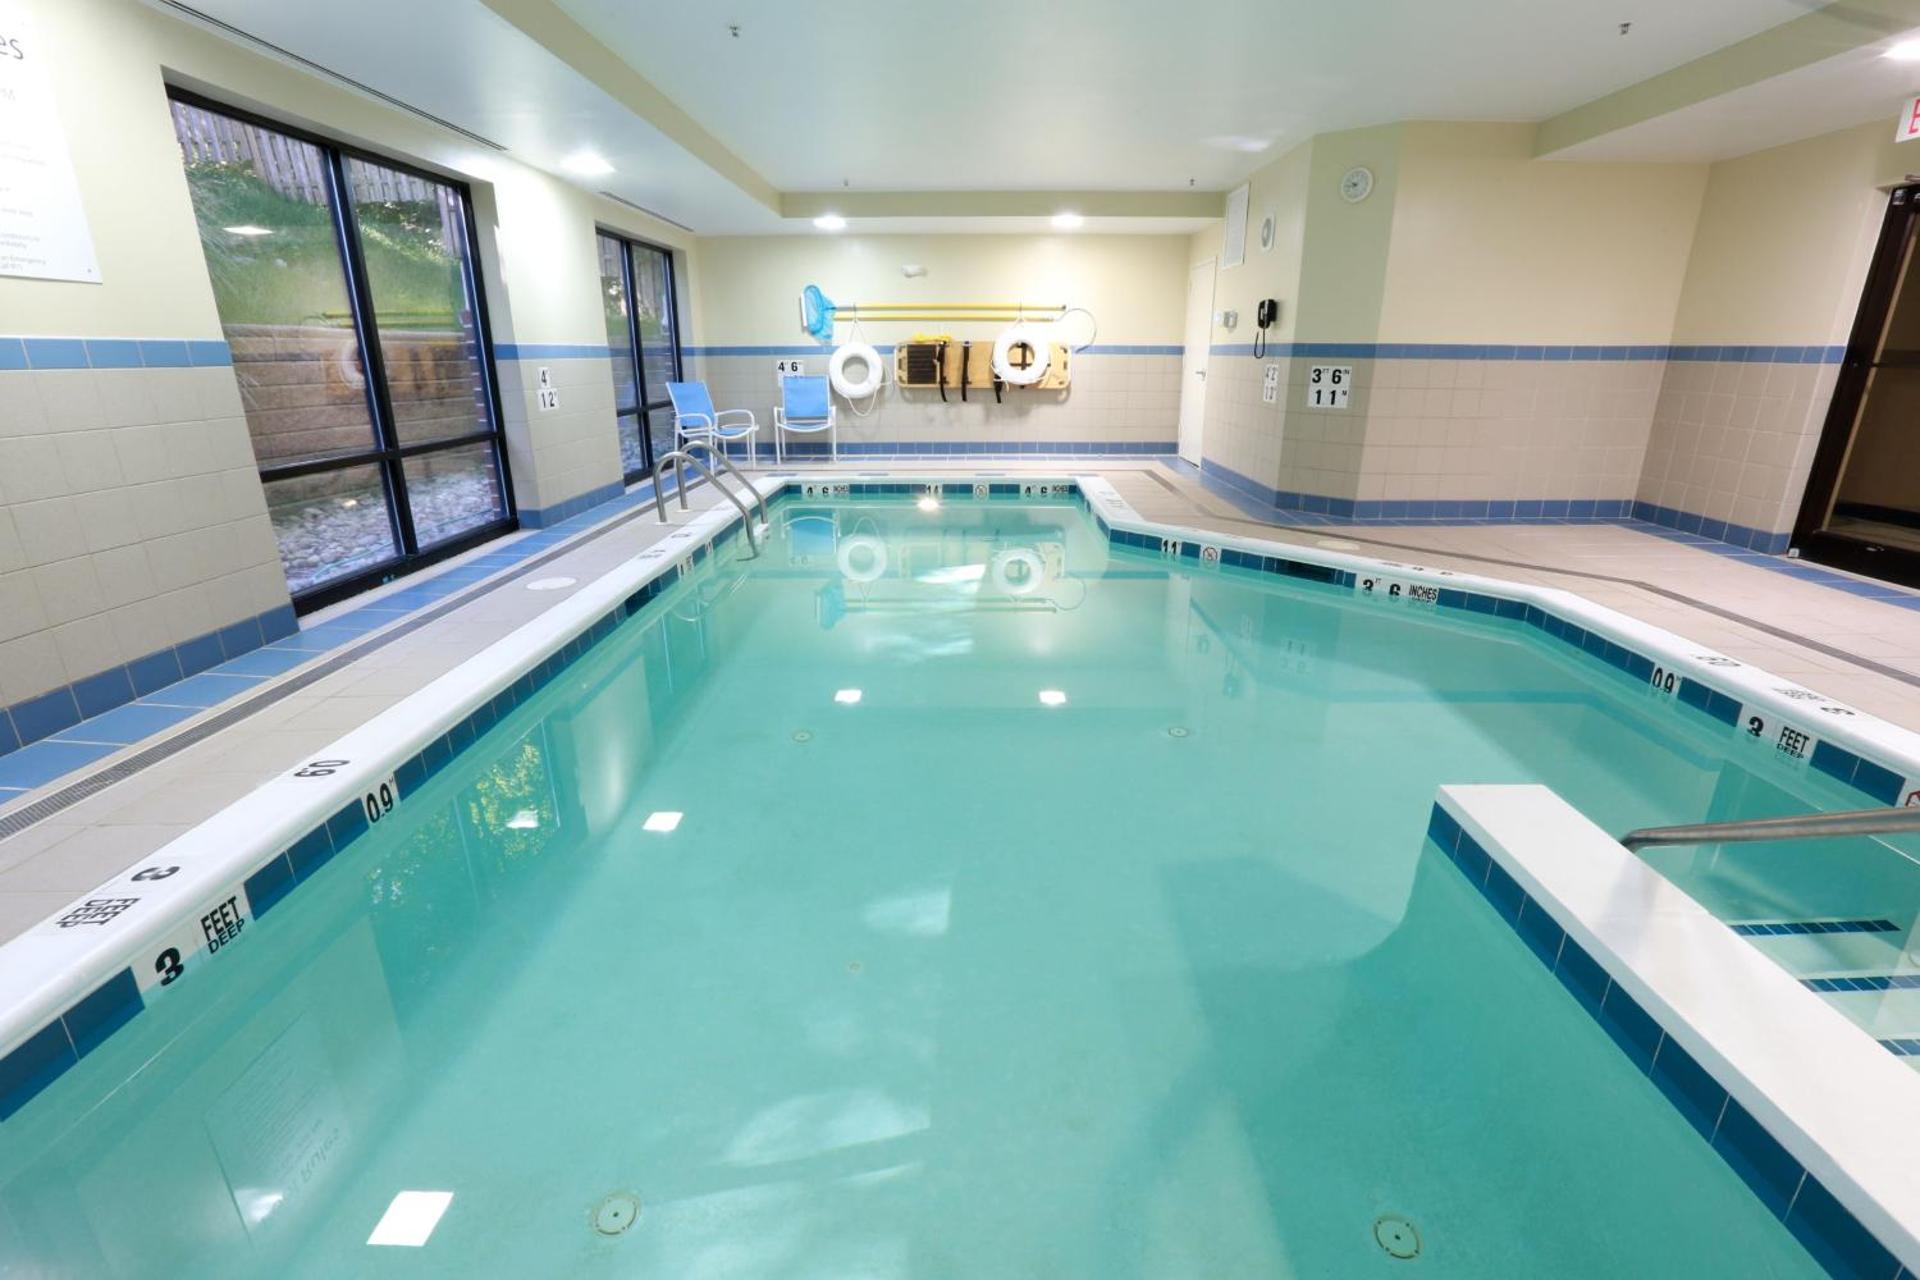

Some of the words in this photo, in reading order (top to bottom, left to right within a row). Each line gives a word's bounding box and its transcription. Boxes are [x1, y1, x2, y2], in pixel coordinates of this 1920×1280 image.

[778, 361, 785, 371] 4
[791, 361, 798, 371] 6
[541, 369, 547, 387] 4
[1312, 368, 1321, 383] 3
[1332, 369, 1341, 384] 6
[1779, 726, 1810, 753] FEET
[131, 866, 181, 882] 3
[155, 946, 184, 987] 3
[200, 895, 237, 942] FEET
[208, 918, 245, 954] DEEP
